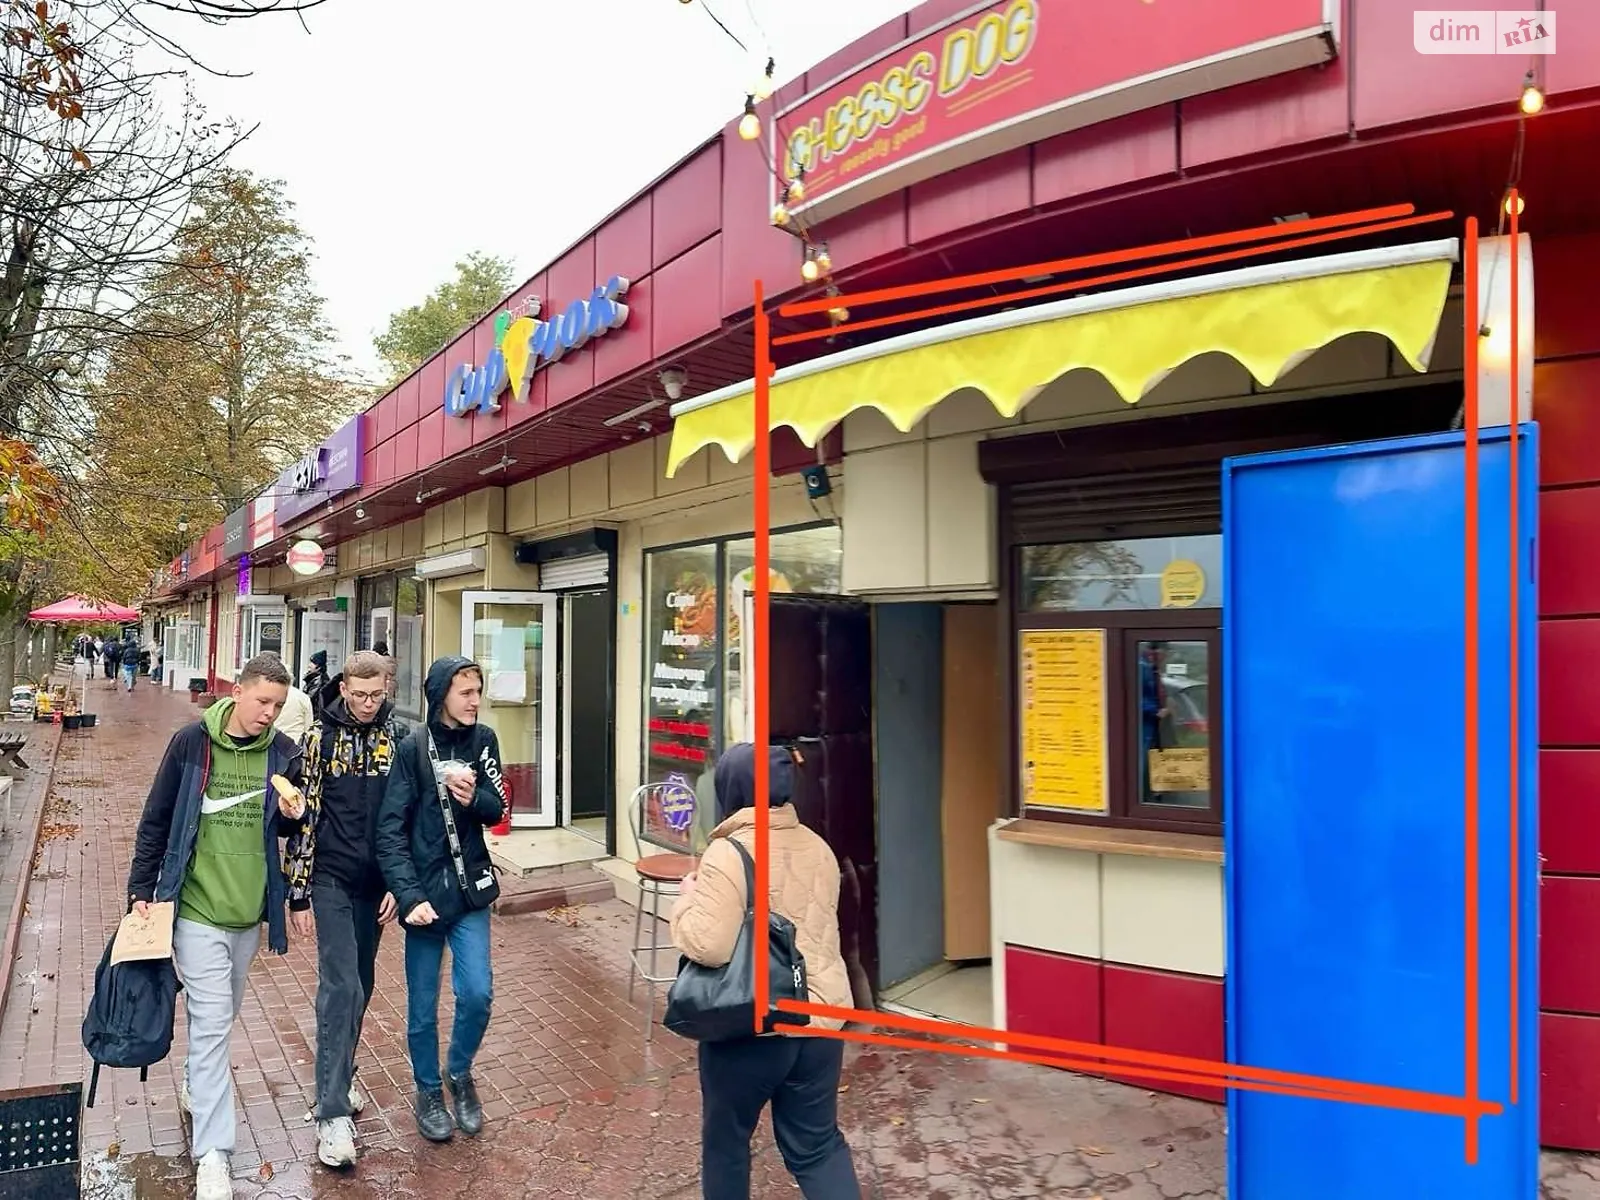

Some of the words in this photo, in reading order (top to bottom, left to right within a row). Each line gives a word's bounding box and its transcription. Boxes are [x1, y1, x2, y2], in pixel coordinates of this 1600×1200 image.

[784, 51, 934, 181] CHEESE
[937, 0, 1038, 97] DOG
[484, 757, 510, 819] Colu
